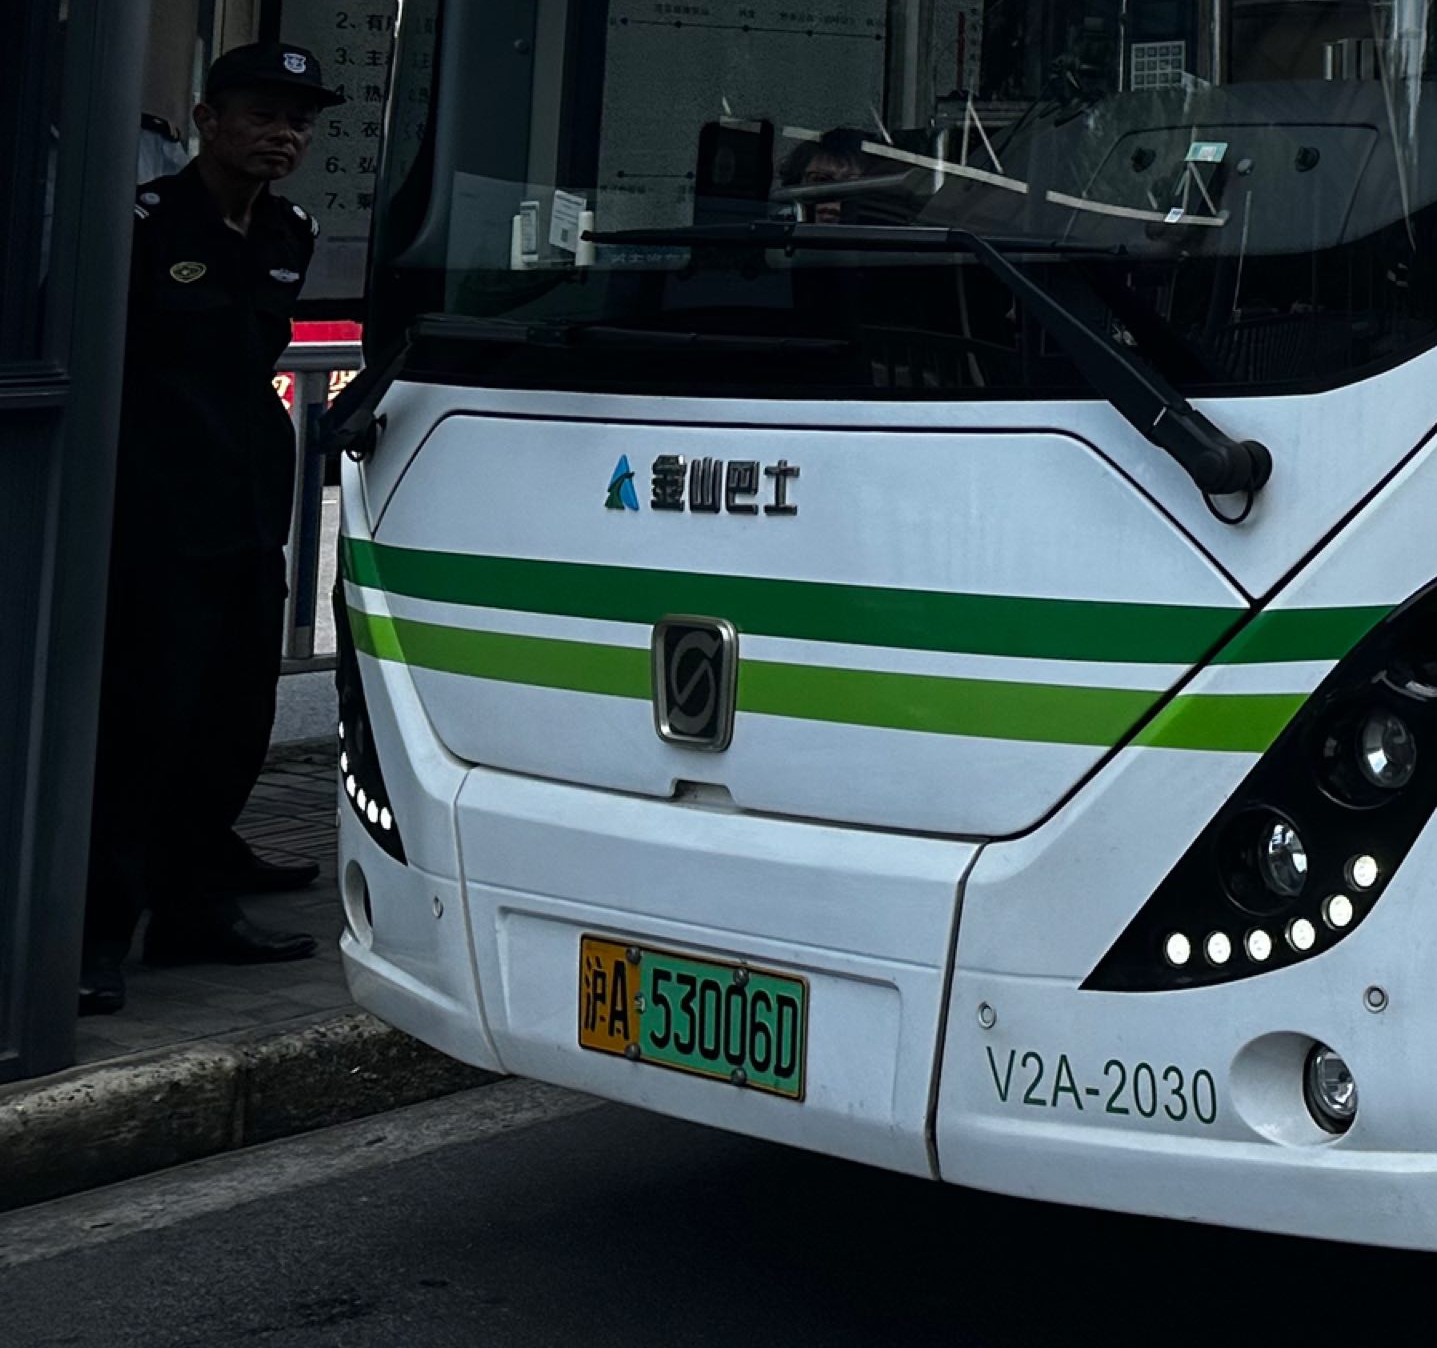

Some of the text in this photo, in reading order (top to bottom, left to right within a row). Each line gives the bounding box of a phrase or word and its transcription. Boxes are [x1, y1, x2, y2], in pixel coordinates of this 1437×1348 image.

[650, 454, 800, 516] 金山巴士
[986, 1046, 1217, 1125] V2A-2030
